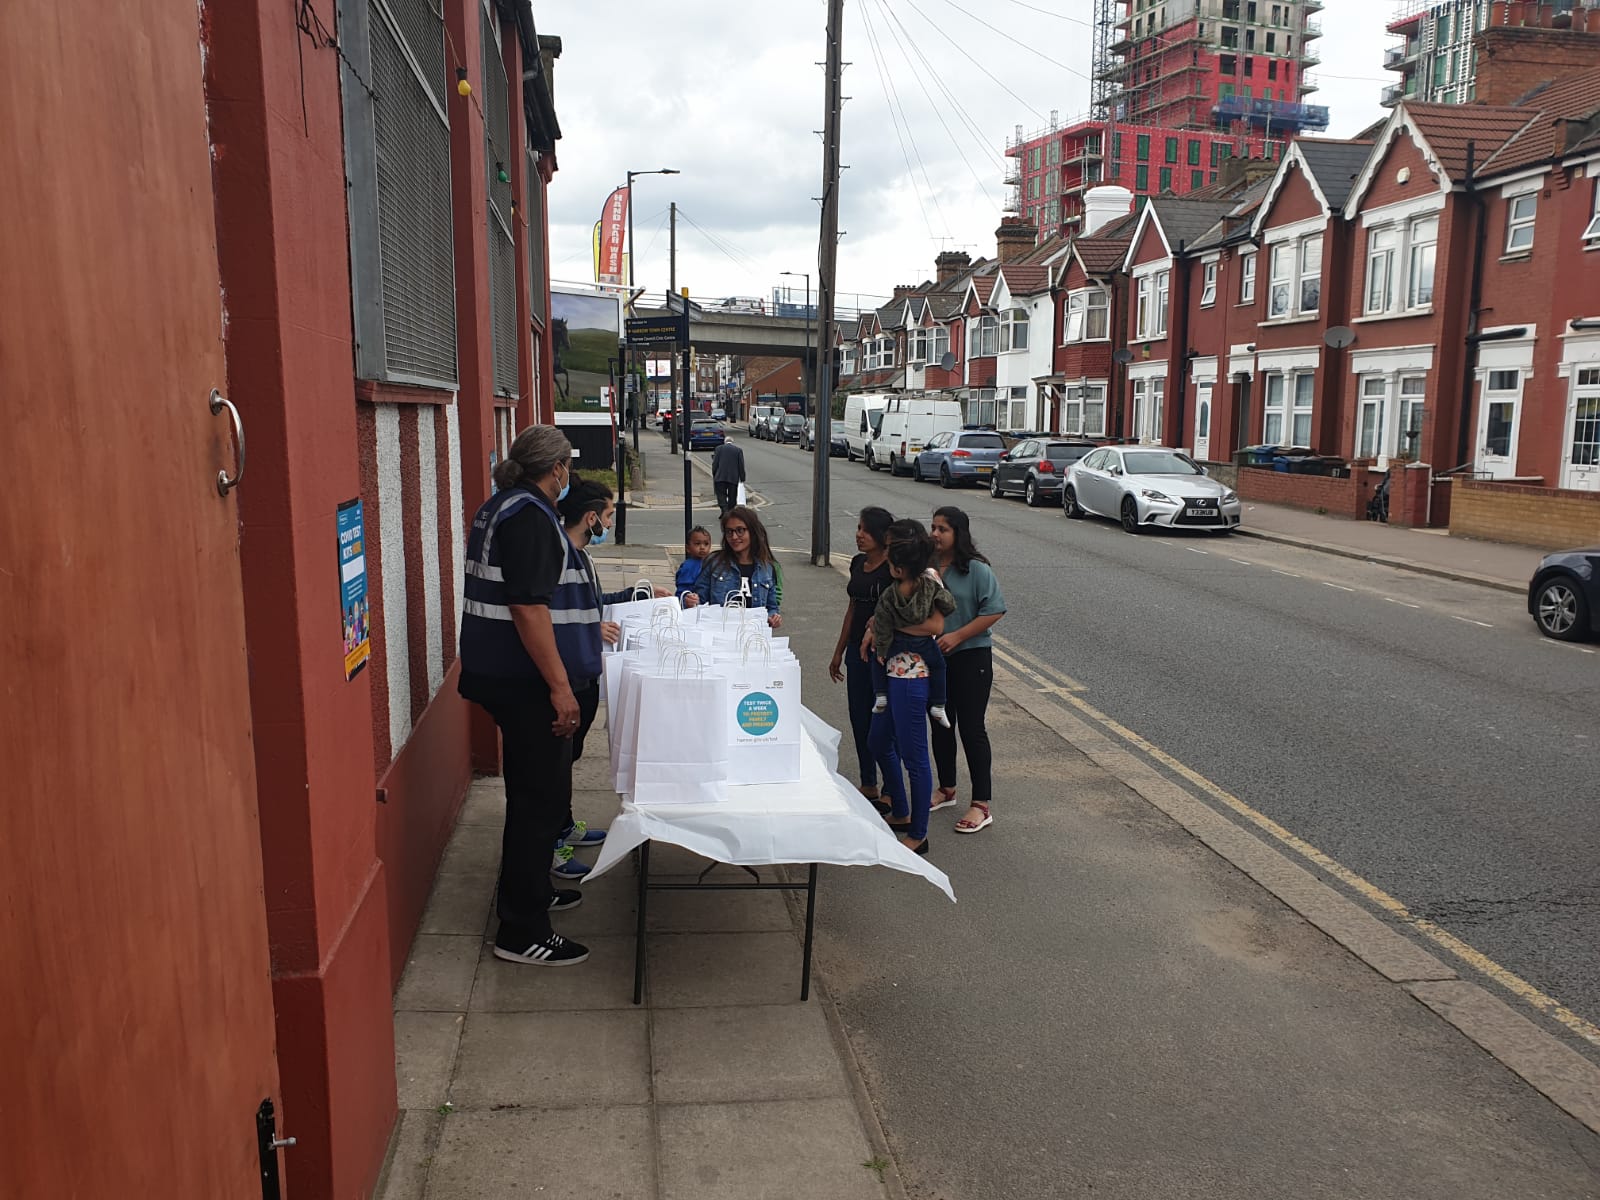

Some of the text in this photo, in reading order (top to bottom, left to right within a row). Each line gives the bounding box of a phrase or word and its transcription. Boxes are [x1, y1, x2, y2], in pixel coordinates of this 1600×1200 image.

[612, 194, 623, 221] HAND
[611, 223, 620, 244] CAR
[609, 246, 619, 272] WASH
[340, 524, 361, 545] COVID TEST
[343, 545, 353, 560] KITS
[740, 577, 752, 597] A
